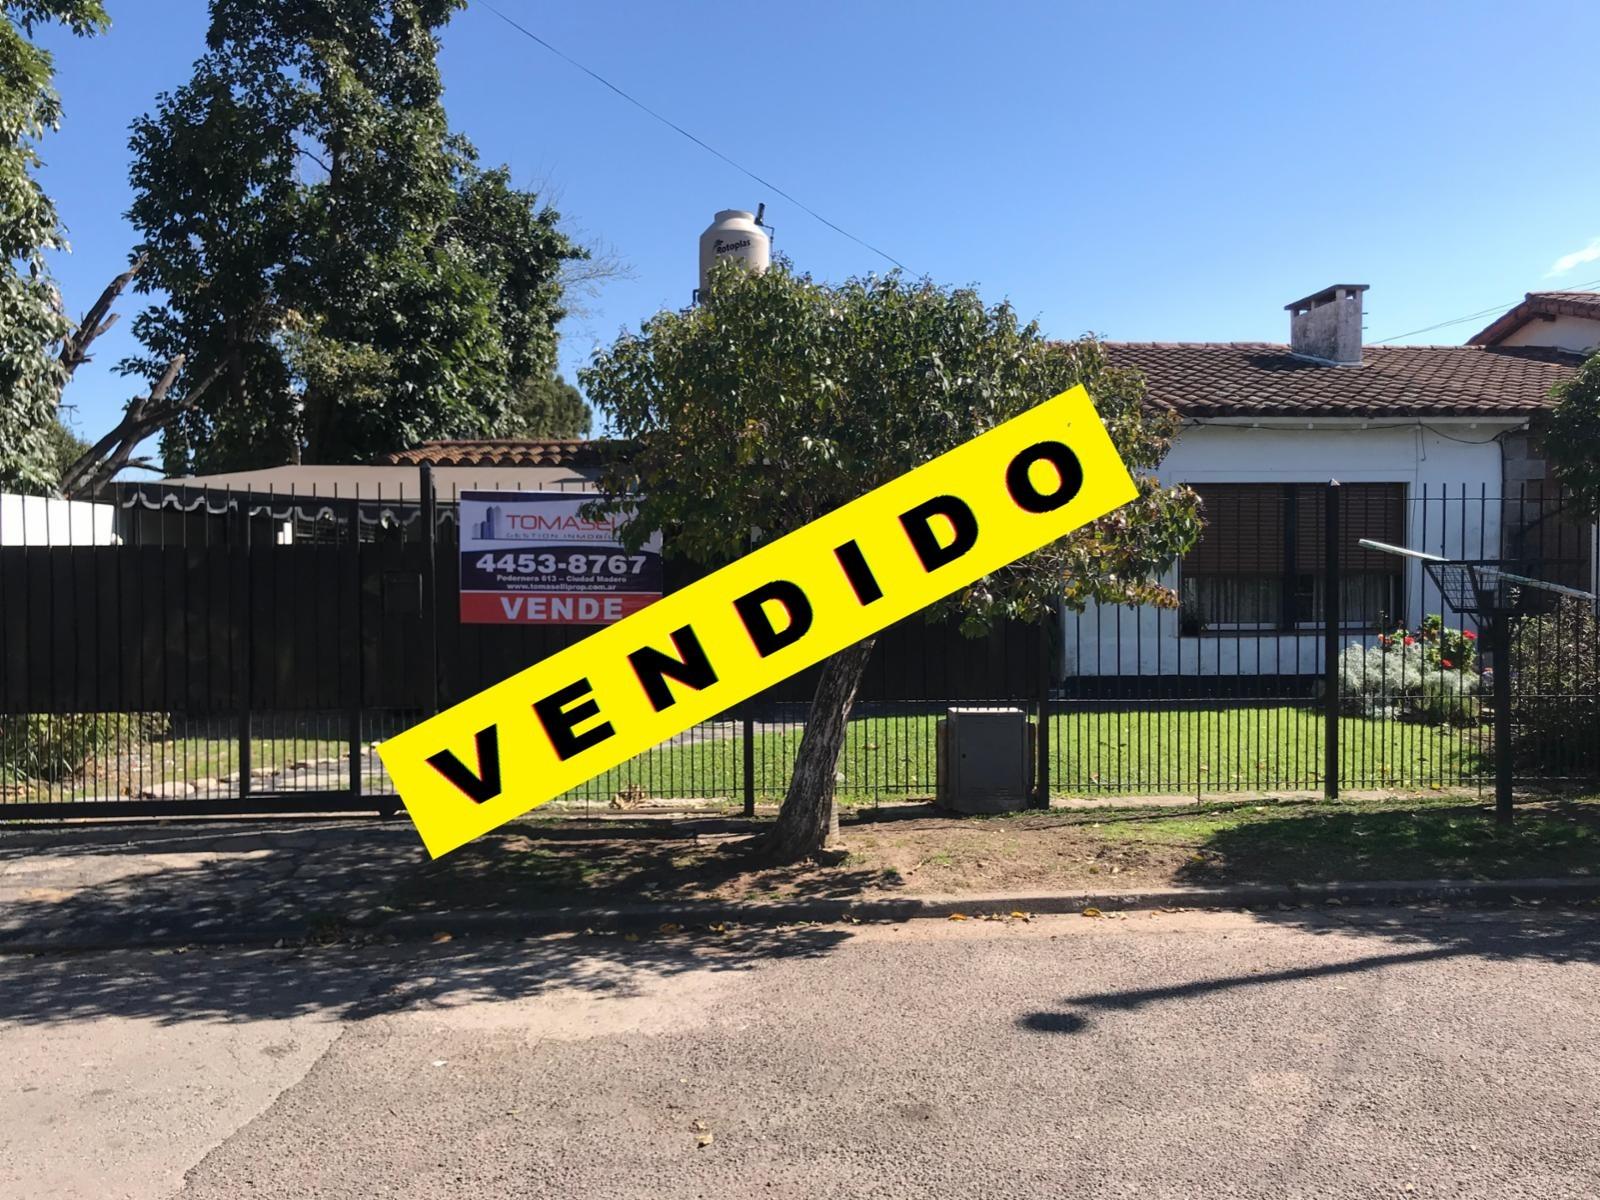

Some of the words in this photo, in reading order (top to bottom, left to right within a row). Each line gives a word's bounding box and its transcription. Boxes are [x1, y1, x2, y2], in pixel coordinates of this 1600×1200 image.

[716, 239, 751, 253] Rotoplas
[506, 515, 616, 531] TOMASEL
[476, 553, 646, 574] 4453-8767
[566, 574, 594, 582] Ciudad
[596, 575, 627, 583] Madero
[500, 598, 623, 620] VENDE
